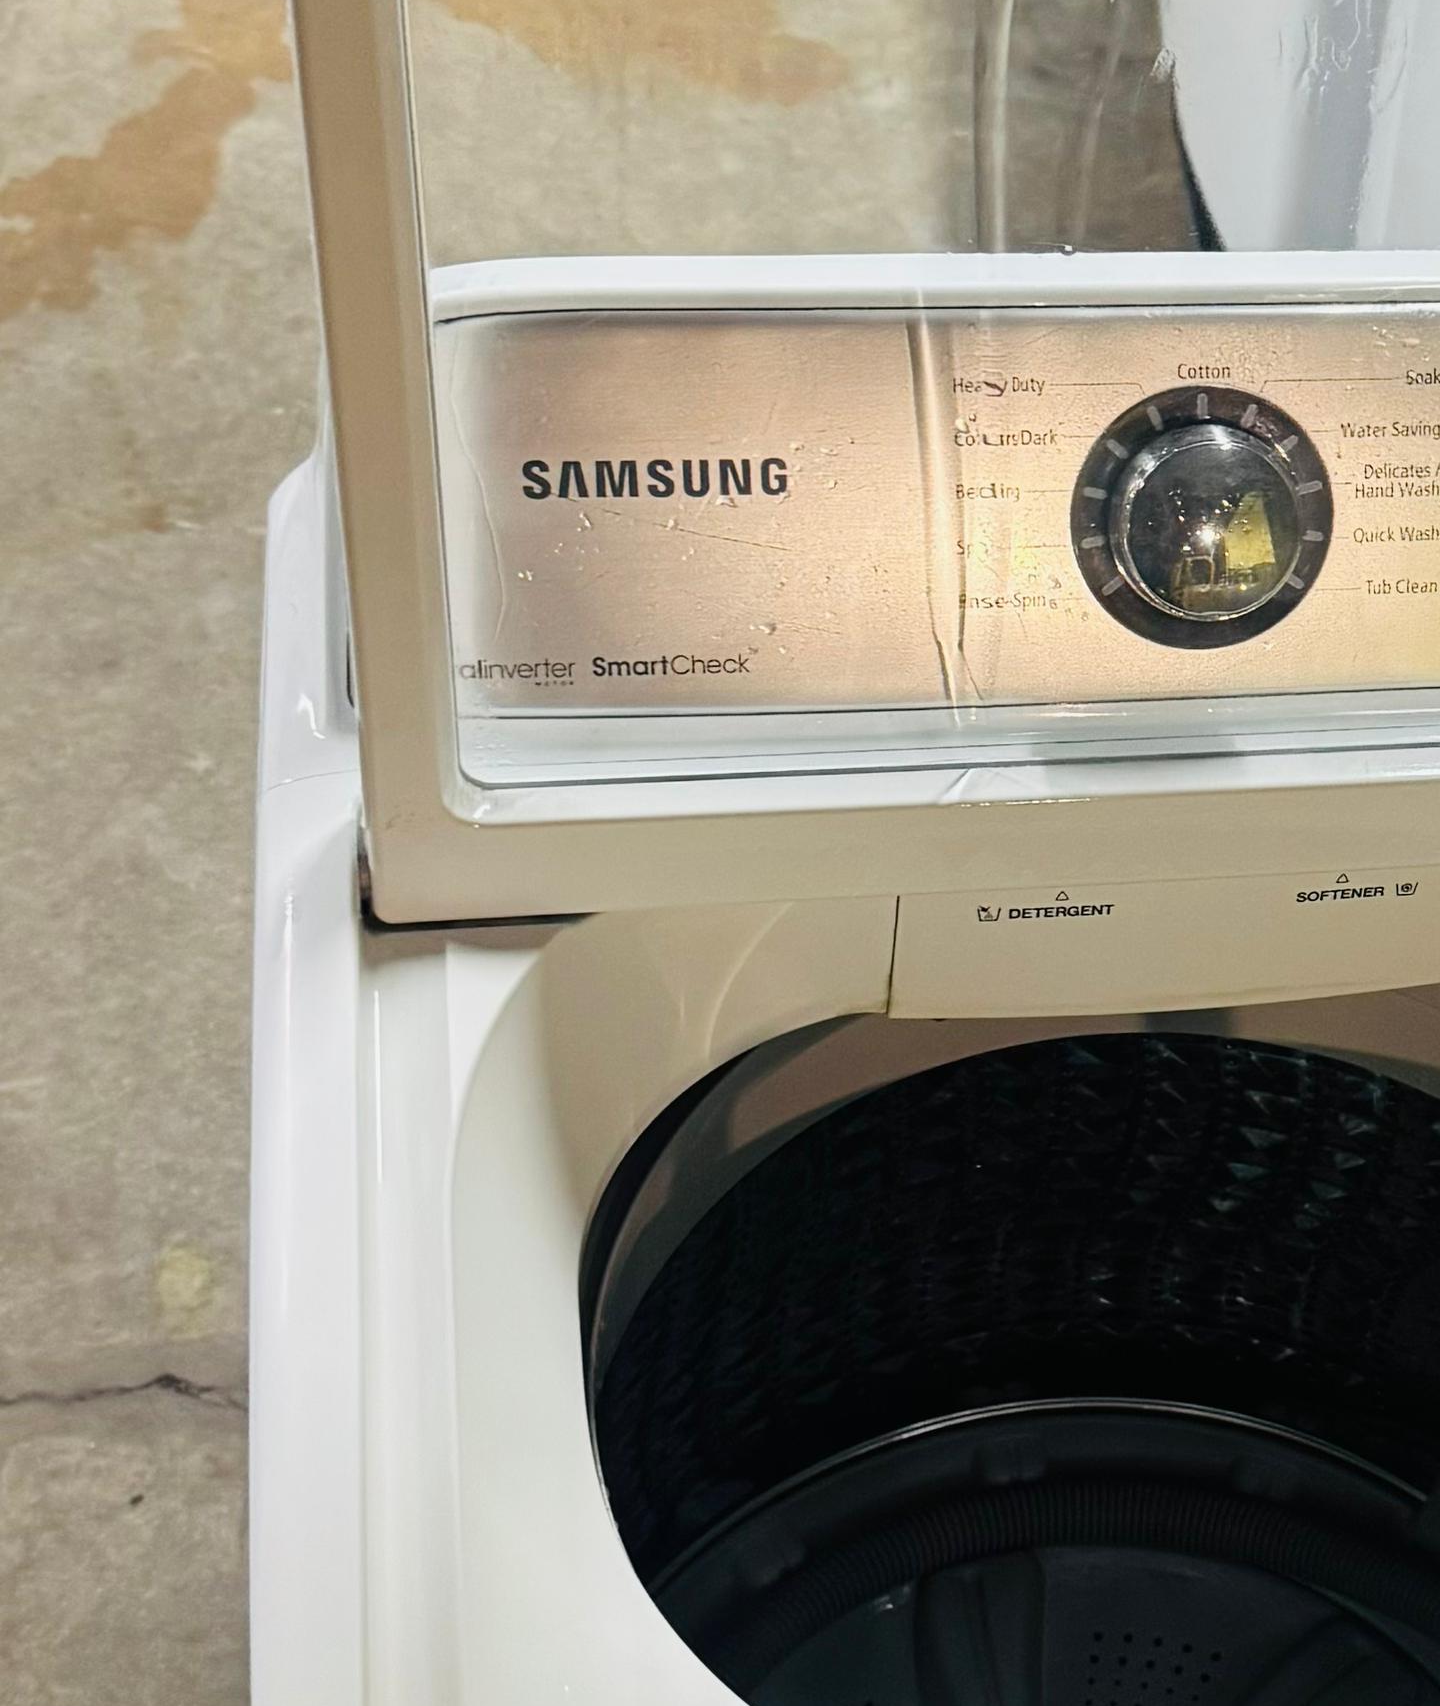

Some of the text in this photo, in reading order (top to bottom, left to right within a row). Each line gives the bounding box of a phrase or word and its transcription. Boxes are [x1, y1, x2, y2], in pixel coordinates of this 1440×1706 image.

[1177, 362, 1231, 380] Cotton
[1012, 376, 1045, 396] Duty
[1021, 428, 1059, 446] Dark
[1341, 420, 1387, 439] Water
[521, 457, 789, 501] SAMSUNG
[1363, 461, 1432, 480] Delicates
[1355, 480, 1440, 499] Hand Wash
[1353, 524, 1440, 546] Quick Wash
[1365, 576, 1439, 596] Tub Clean
[591, 654, 751, 678] SmartCheck
[1295, 886, 1385, 904] SOFTENER
[1008, 903, 1115, 921] DETERGENT
